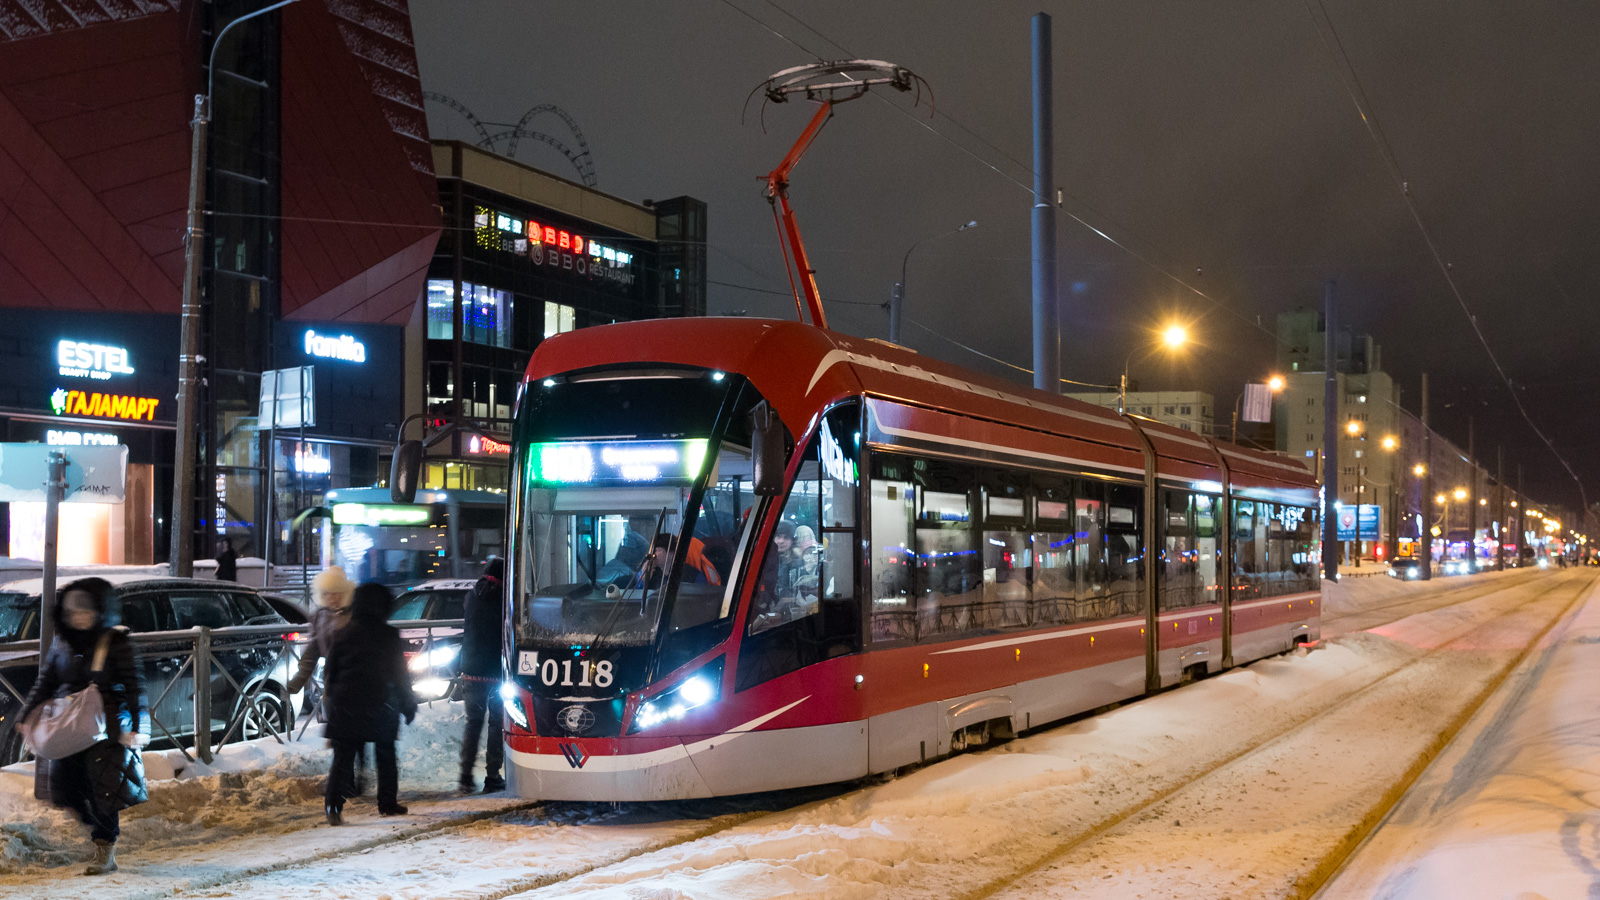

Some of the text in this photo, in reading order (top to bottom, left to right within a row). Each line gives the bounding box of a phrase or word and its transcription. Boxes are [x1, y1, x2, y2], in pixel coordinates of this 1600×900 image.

[548, 249, 586, 274] BBQ
[589, 262, 636, 285] RESTAURANT
[59, 340, 135, 375] ESTEL
[65, 390, 159, 421] ГАЛАМАРТ
[541, 658, 614, 688] 0118
